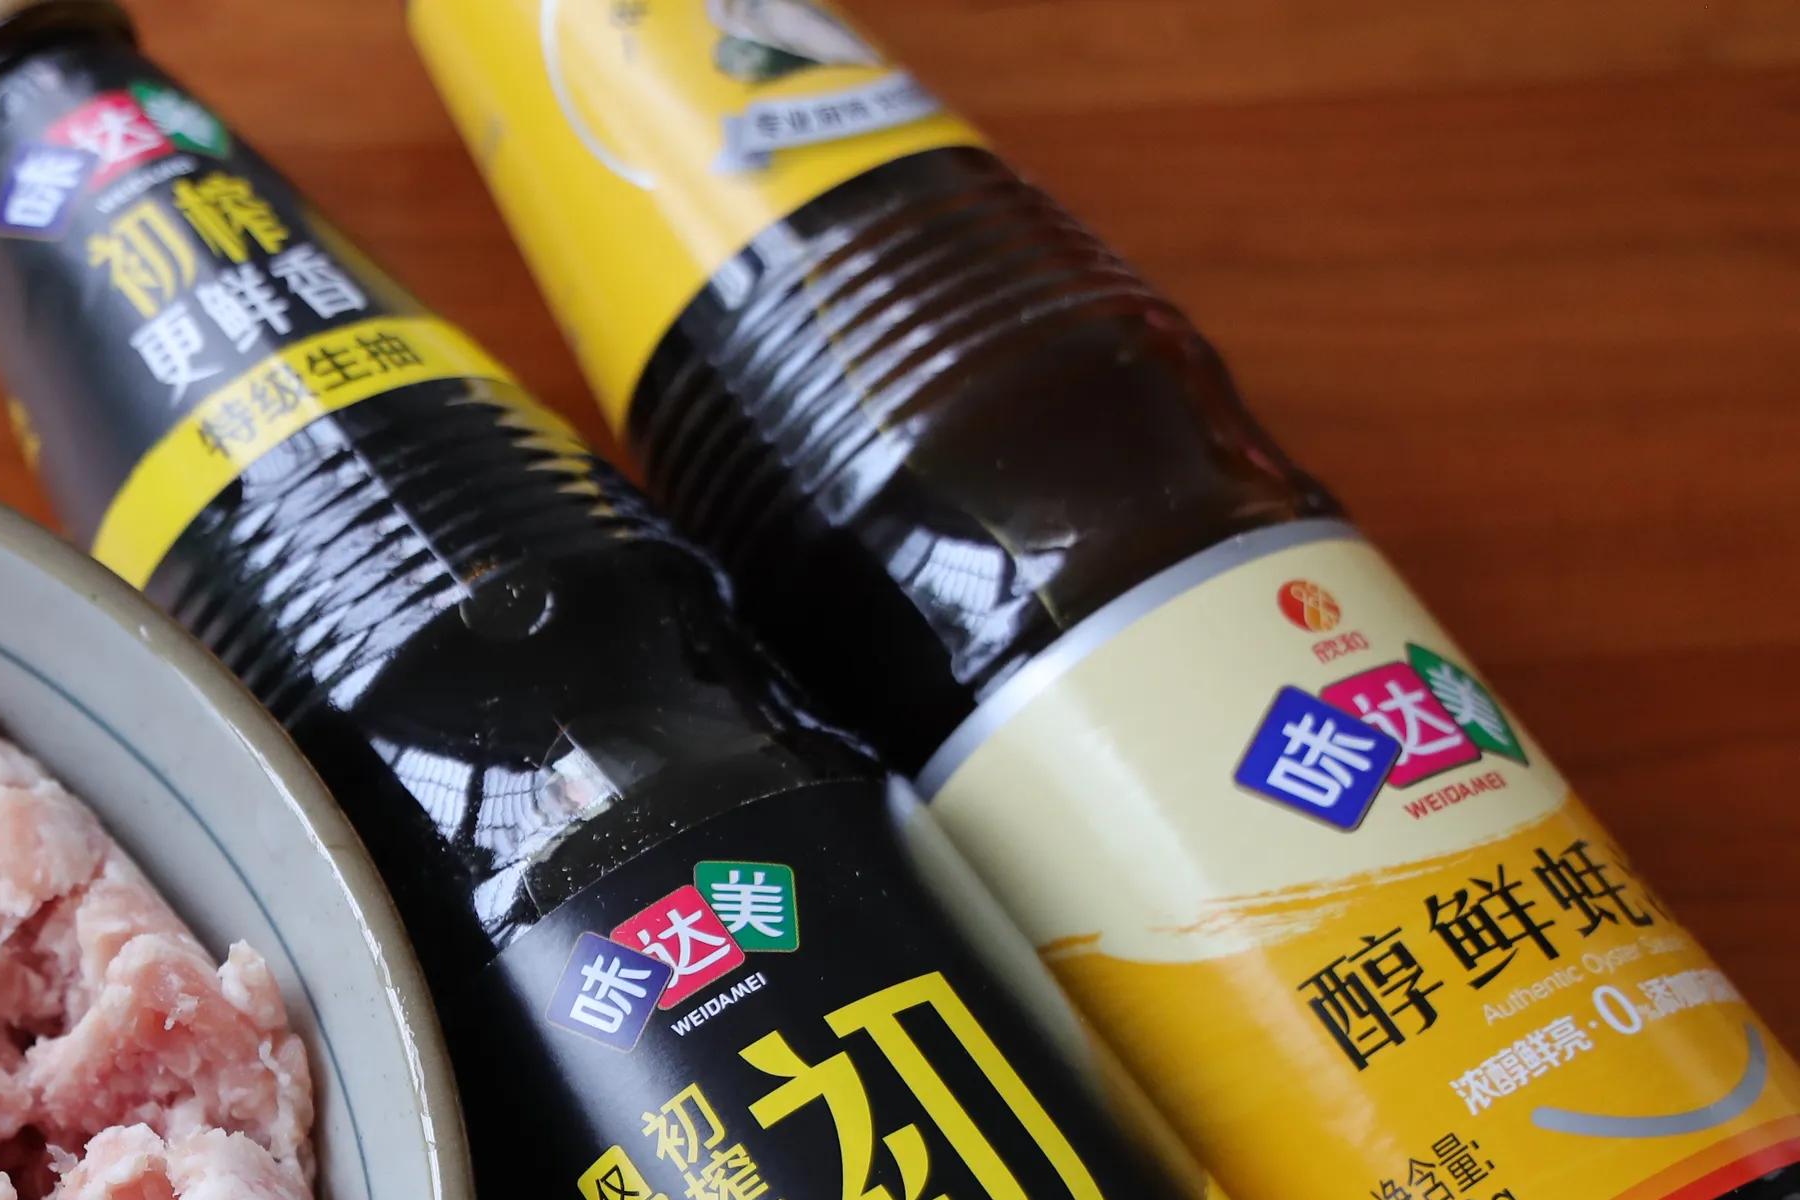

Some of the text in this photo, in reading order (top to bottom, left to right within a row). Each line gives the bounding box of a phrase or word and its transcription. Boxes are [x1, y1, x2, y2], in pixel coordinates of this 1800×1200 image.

[87, 171, 290, 320] 初榨
[129, 243, 367, 405] 更鲜香
[196, 332, 425, 459] 特级生抽
[1266, 661, 1510, 808] 味达美
[1404, 771, 1507, 821] WEIDAMEI
[569, 869, 784, 1034] 味达美
[671, 972, 767, 1038] WEIDAMEI
[1297, 838, 1670, 1070] 醇鲜蚝
[1482, 964, 1584, 1026] Authentic
